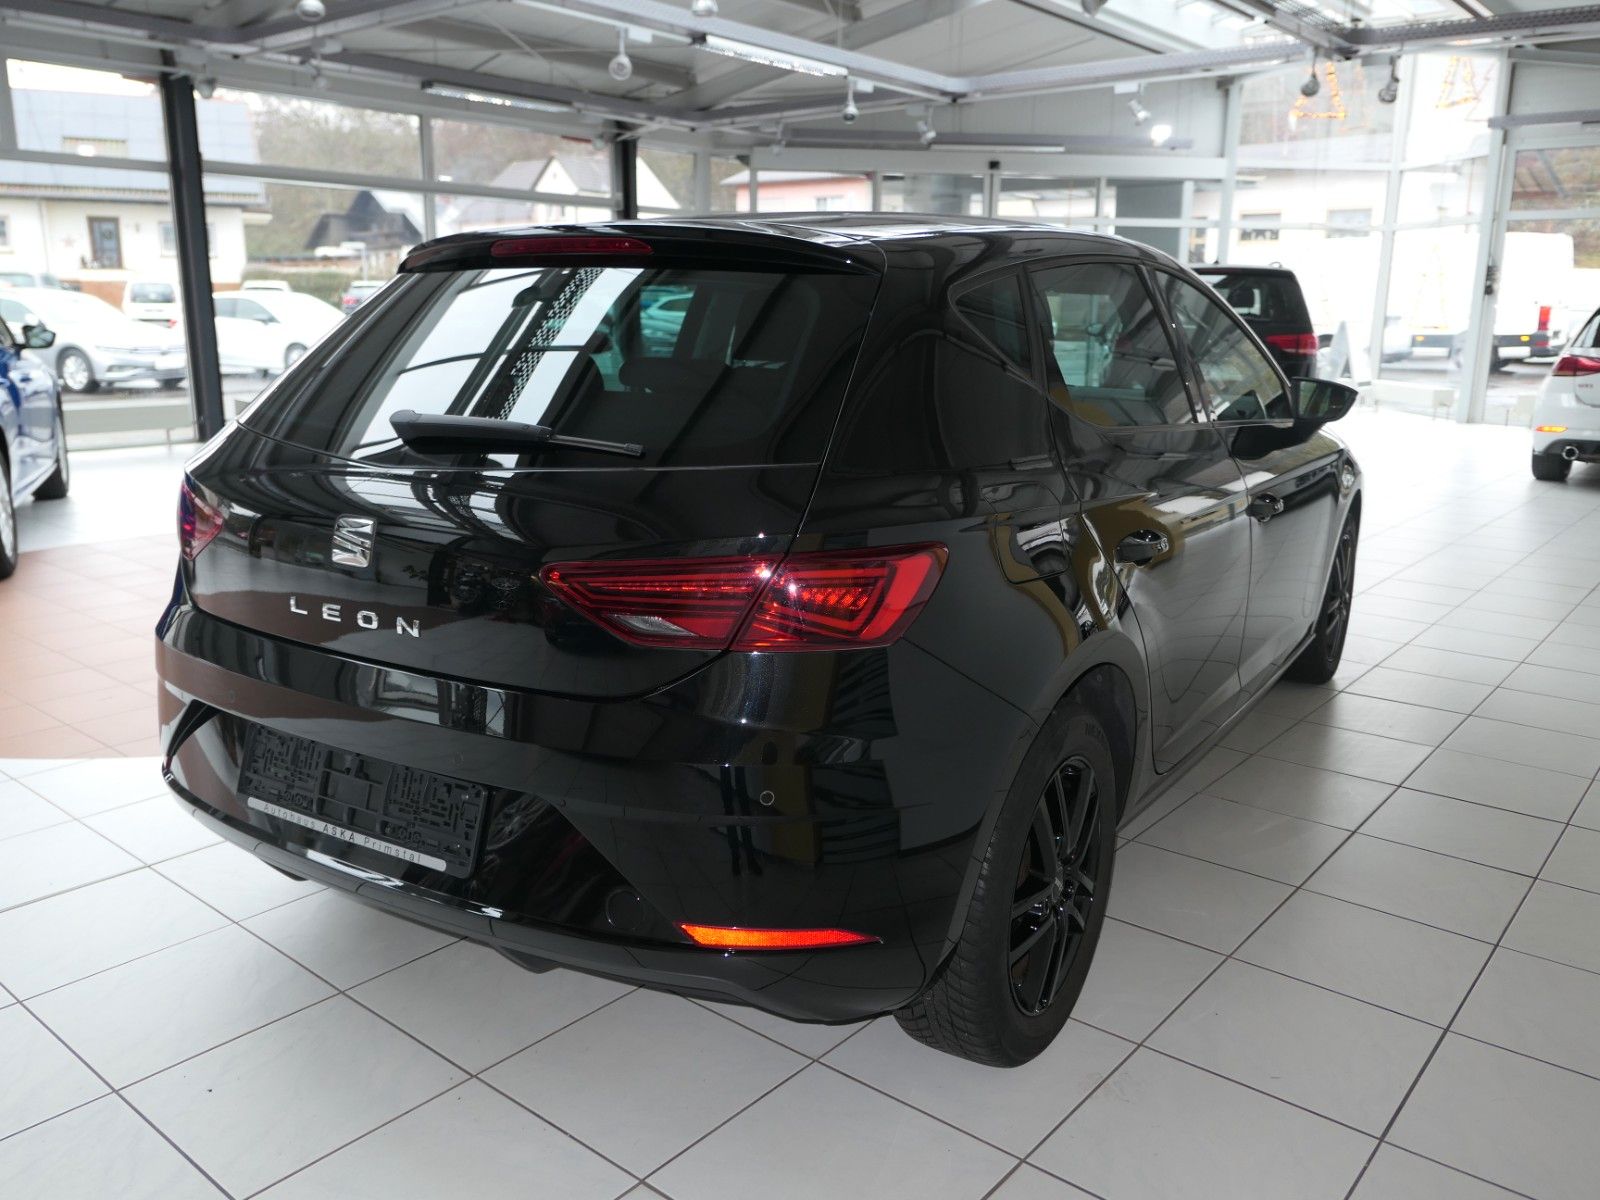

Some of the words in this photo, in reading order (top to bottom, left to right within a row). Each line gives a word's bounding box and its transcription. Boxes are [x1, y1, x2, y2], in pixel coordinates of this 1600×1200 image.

[290, 596, 420, 638] LEON
[263, 803, 315, 830] Autohaus
[322, 823, 356, 843] ASKA
[364, 836, 421, 863] Primstal
